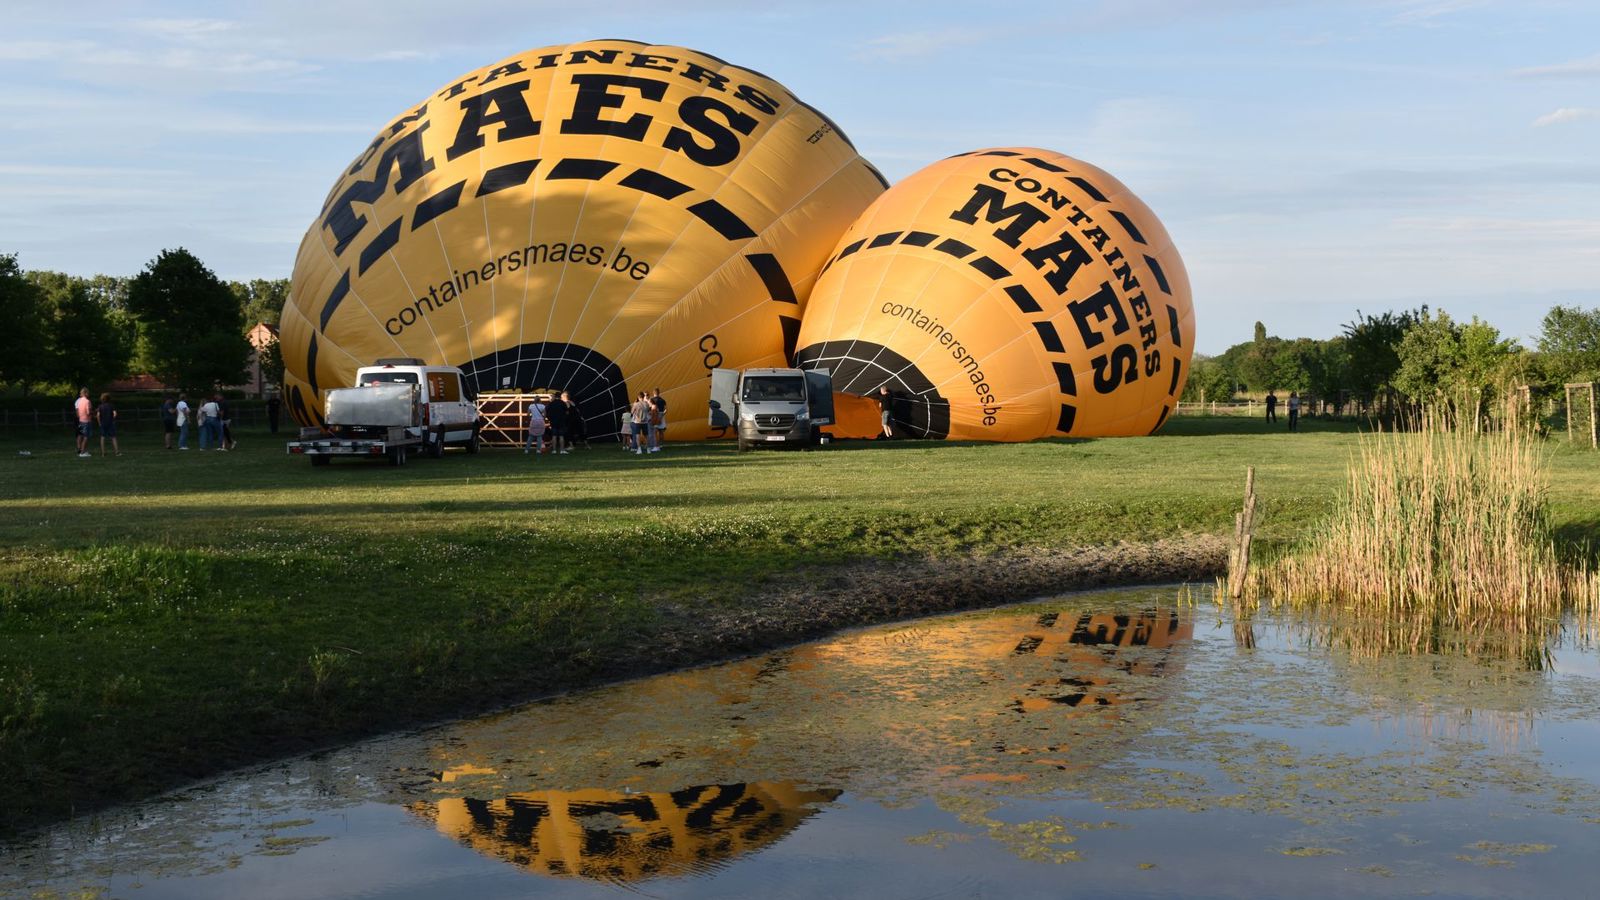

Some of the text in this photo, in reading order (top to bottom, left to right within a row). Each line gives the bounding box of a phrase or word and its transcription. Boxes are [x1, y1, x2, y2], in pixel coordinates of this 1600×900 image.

[321, 73, 760, 258] MAES
[385, 242, 650, 336] containersmaes.be
[881, 301, 1002, 426] containersmaes.be
[949, 183, 1139, 395] MAES
[988, 167, 1162, 378] CONTAINERS
